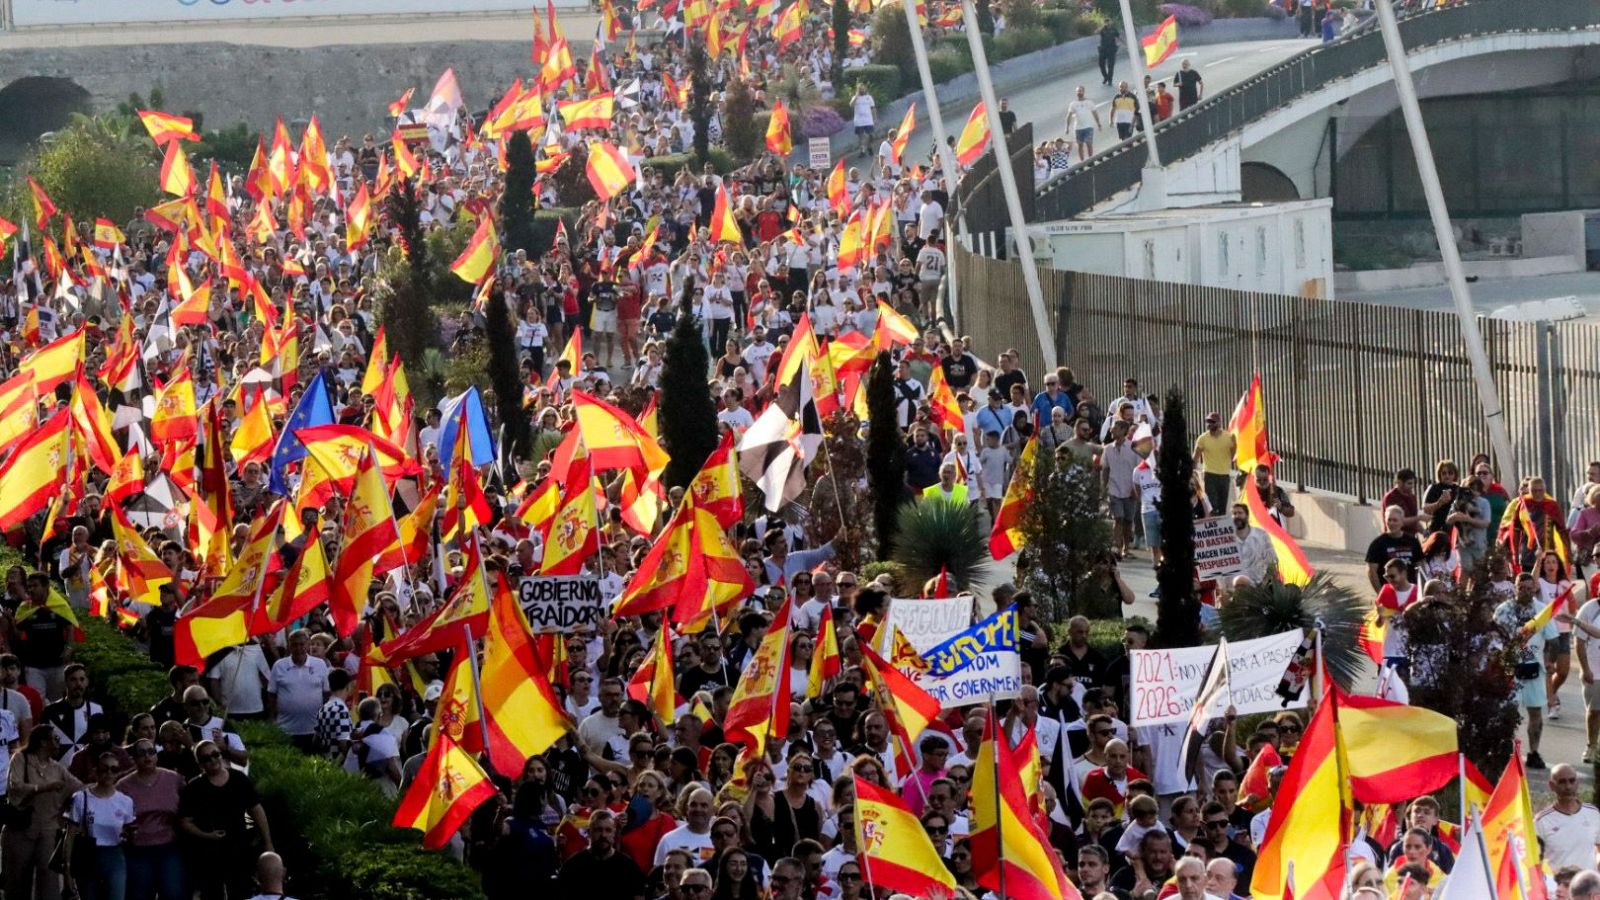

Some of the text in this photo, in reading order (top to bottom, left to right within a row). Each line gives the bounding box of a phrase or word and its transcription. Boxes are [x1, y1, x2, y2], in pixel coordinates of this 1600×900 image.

[926, 255, 940, 271] 21
[1204, 521, 1218, 529] LAS
[1197, 546, 1238, 560] HACEN FALTA
[1199, 556, 1241, 570] RESPUESTAS
[520, 578, 600, 602] GOBIERNO
[952, 676, 1020, 699] GOVERNMEN
